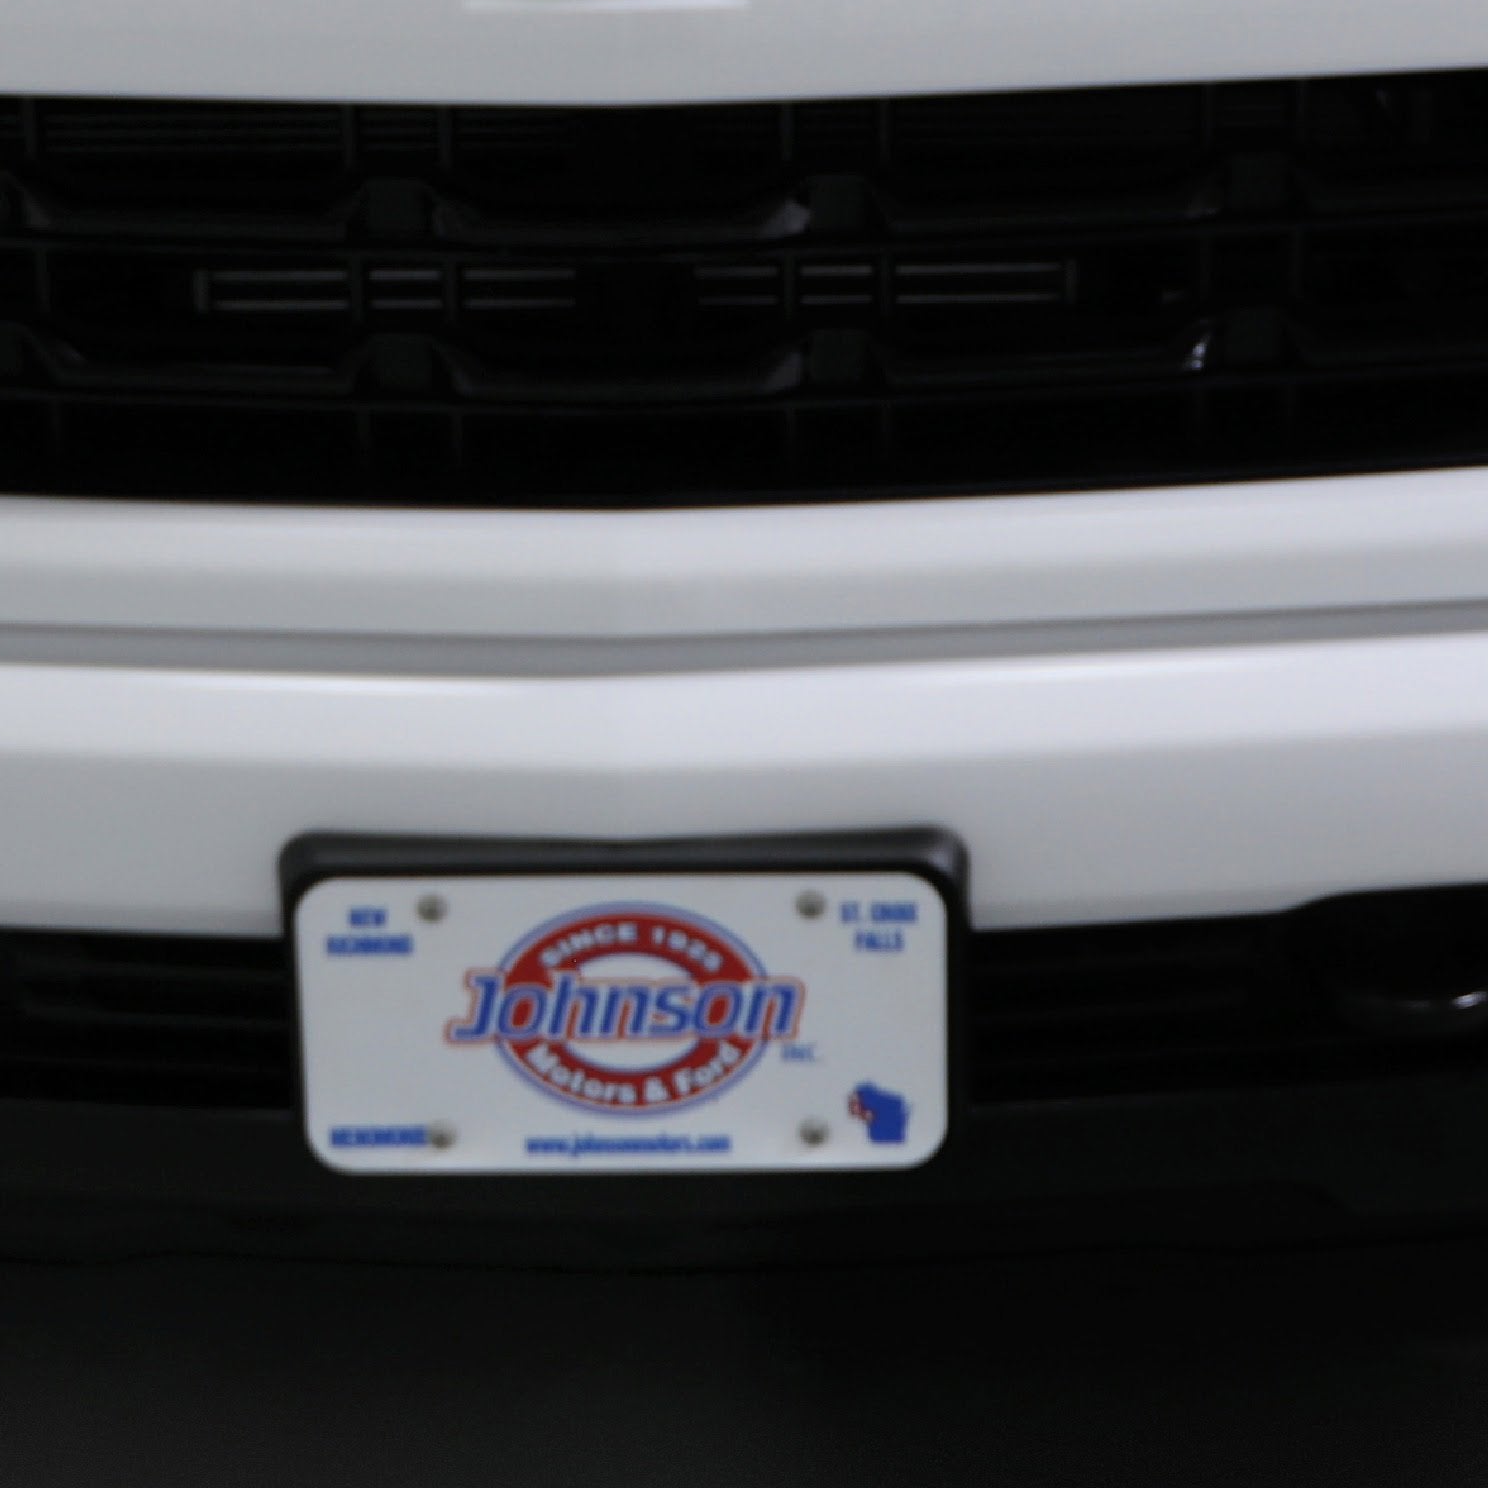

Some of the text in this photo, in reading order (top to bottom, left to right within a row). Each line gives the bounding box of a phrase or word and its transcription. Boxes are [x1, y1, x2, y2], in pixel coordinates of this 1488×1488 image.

[540, 920, 638, 969] SINCE
[446, 966, 804, 1044] Johnson
[526, 1039, 742, 1105] Motors & Ford
